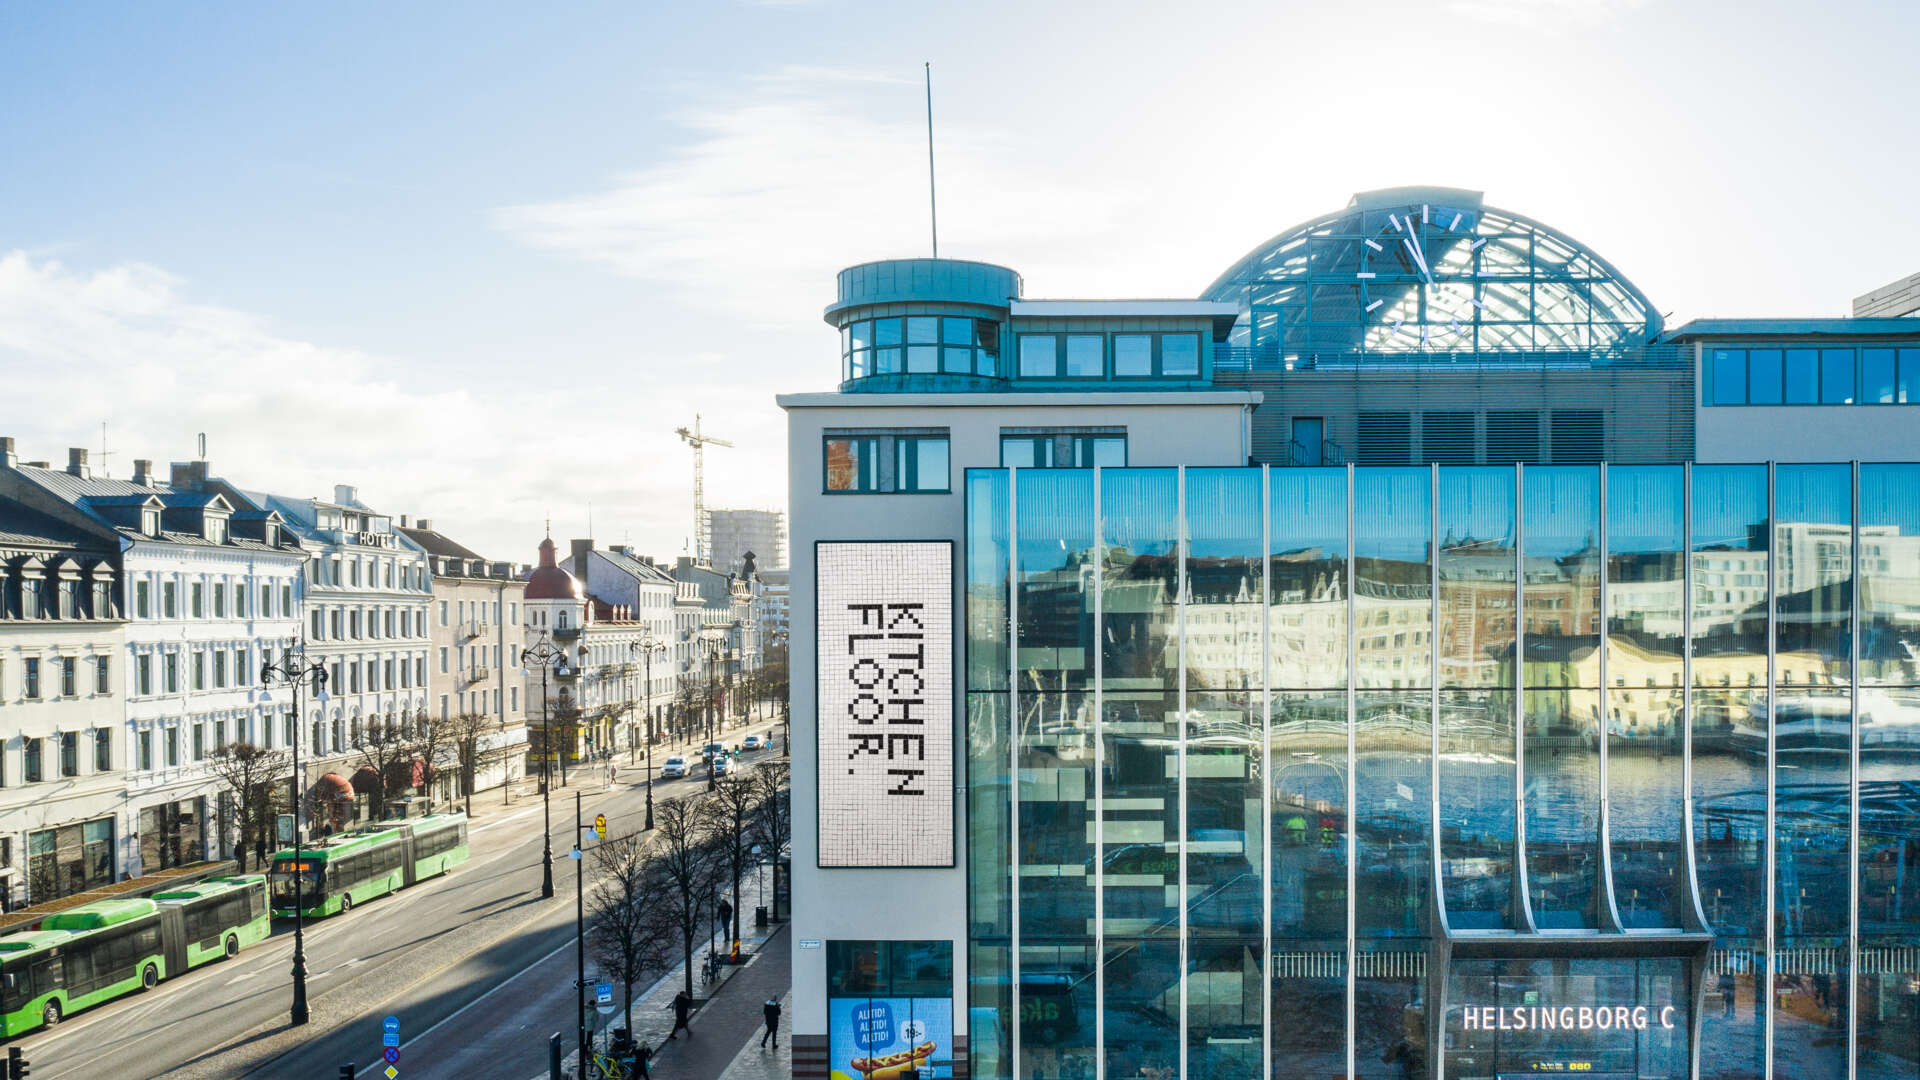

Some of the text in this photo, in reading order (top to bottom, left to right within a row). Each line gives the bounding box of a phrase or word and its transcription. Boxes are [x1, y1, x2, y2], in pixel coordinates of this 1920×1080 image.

[848, 604, 884, 774] FLOOR.
[888, 603, 924, 795] KITCHEN
[860, 1018, 887, 1032] ALTID!
[1463, 1006, 1675, 1030] HELSINGBORG C
